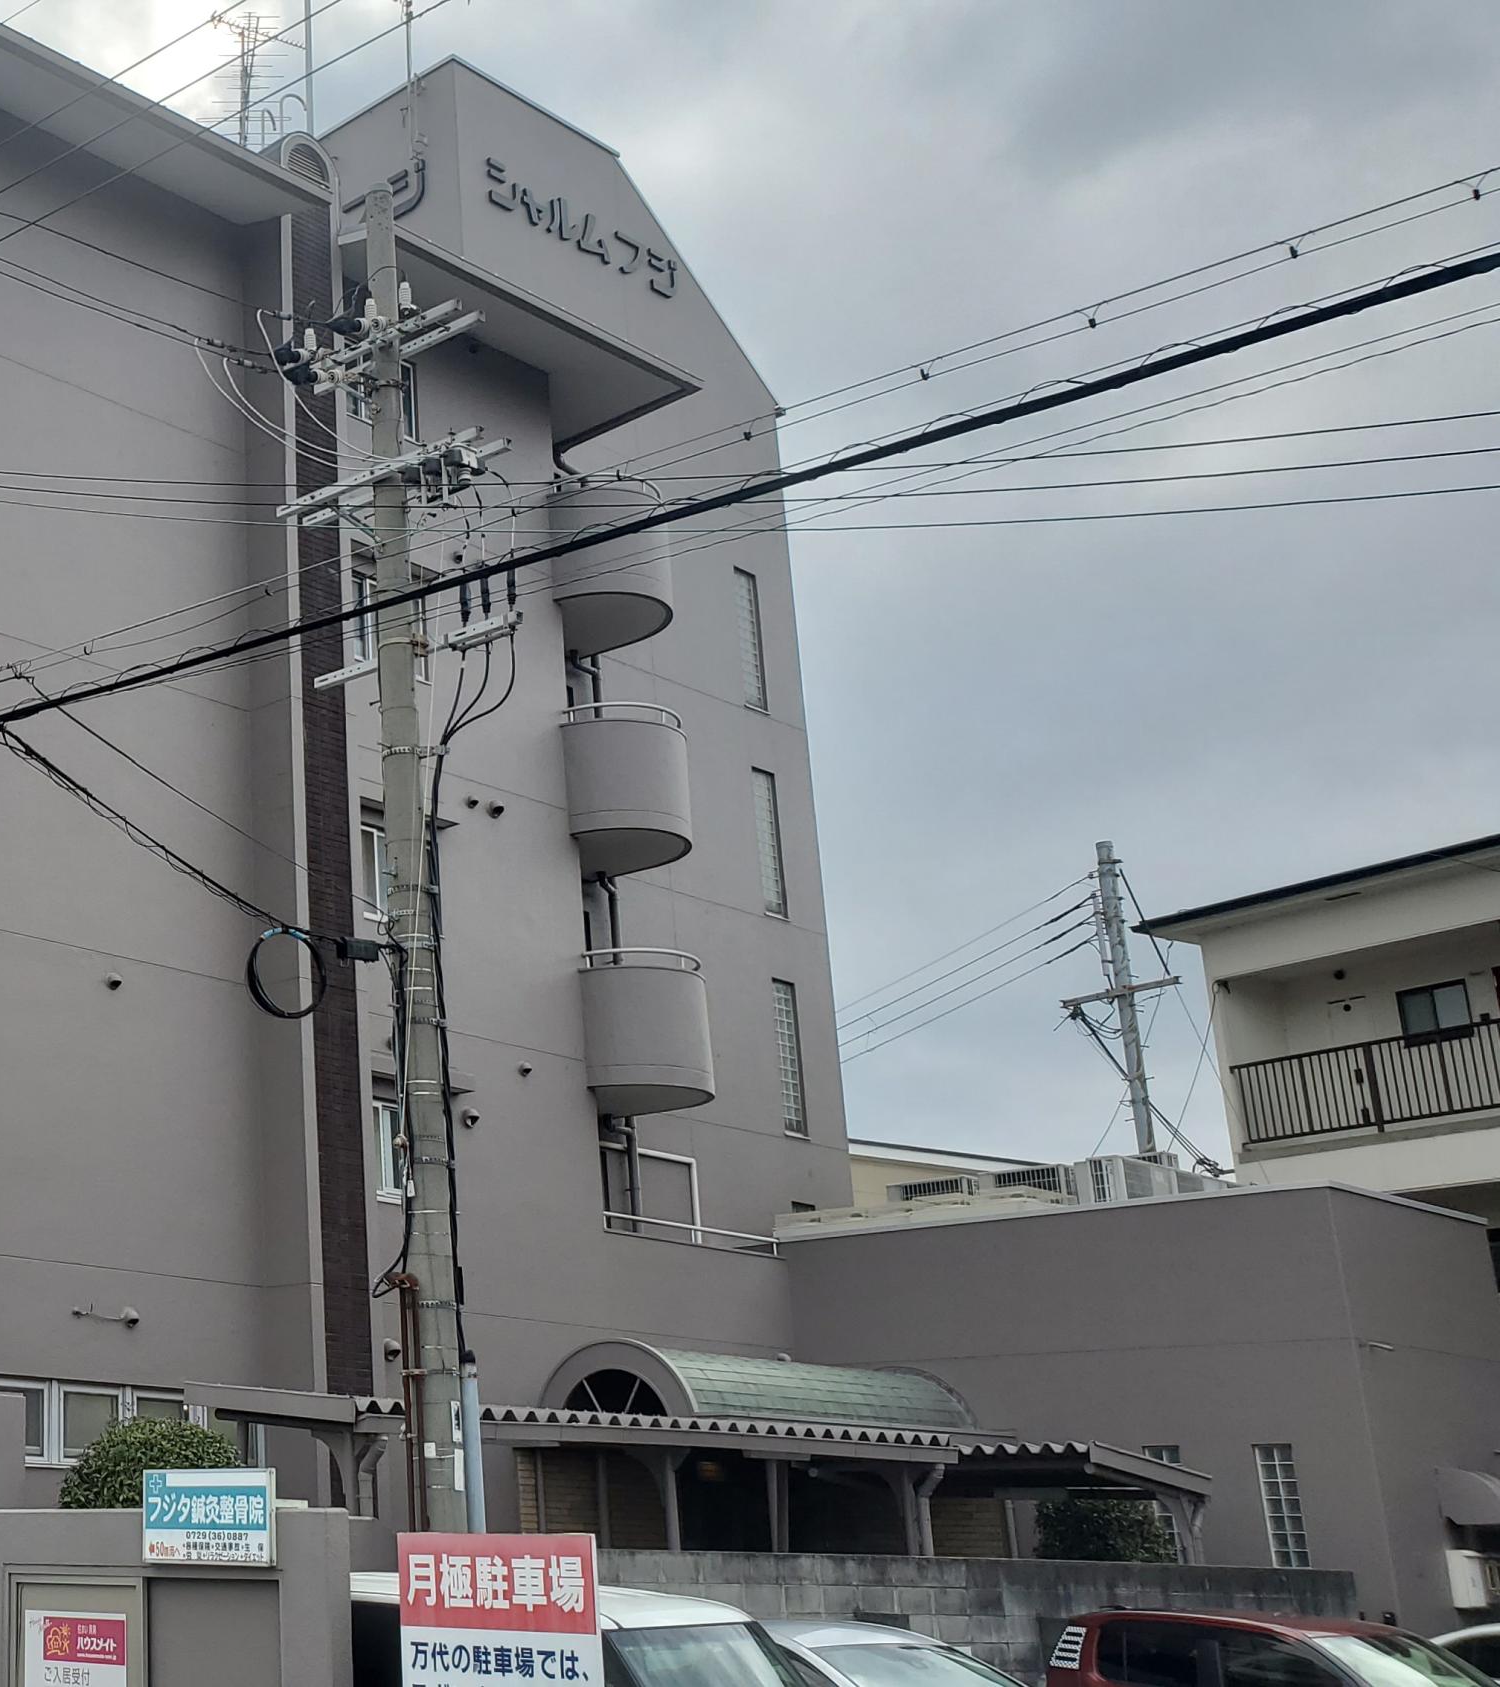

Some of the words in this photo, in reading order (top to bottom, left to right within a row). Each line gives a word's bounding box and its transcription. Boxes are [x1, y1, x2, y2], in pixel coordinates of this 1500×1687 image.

[486, 156, 678, 299] シャルムフジ
[148, 1493, 264, 1525] フジタ鍼灸整骨院
[185, 1530, 249, 1541] 0729(36)0887
[407, 1553, 586, 1614] 月極駐車場
[76, 1636, 117, 1652] ハウスメイト
[44, 1666, 91, 1687] ご入居受付
[410, 1641, 589, 1682] 万代の駐車場では、
